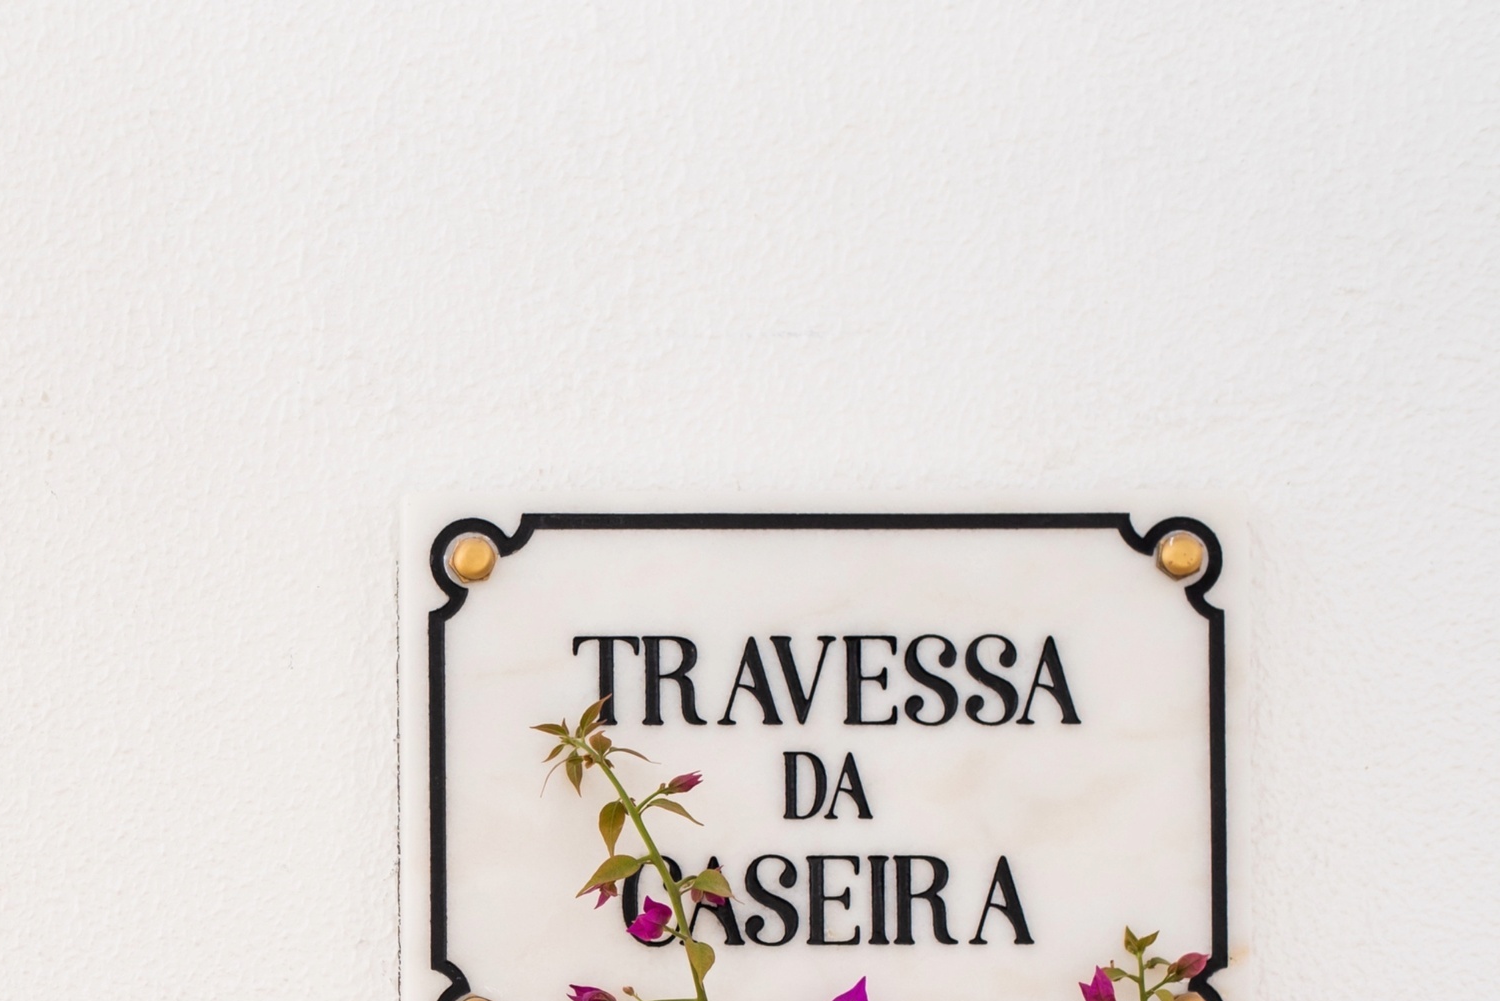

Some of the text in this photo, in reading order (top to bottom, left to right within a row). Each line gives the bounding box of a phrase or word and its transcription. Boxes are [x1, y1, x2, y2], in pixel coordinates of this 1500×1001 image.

[572, 634, 1082, 726] TRAVESSA
[783, 751, 873, 820] DA
[622, 854, 1034, 947] CASEIRA
